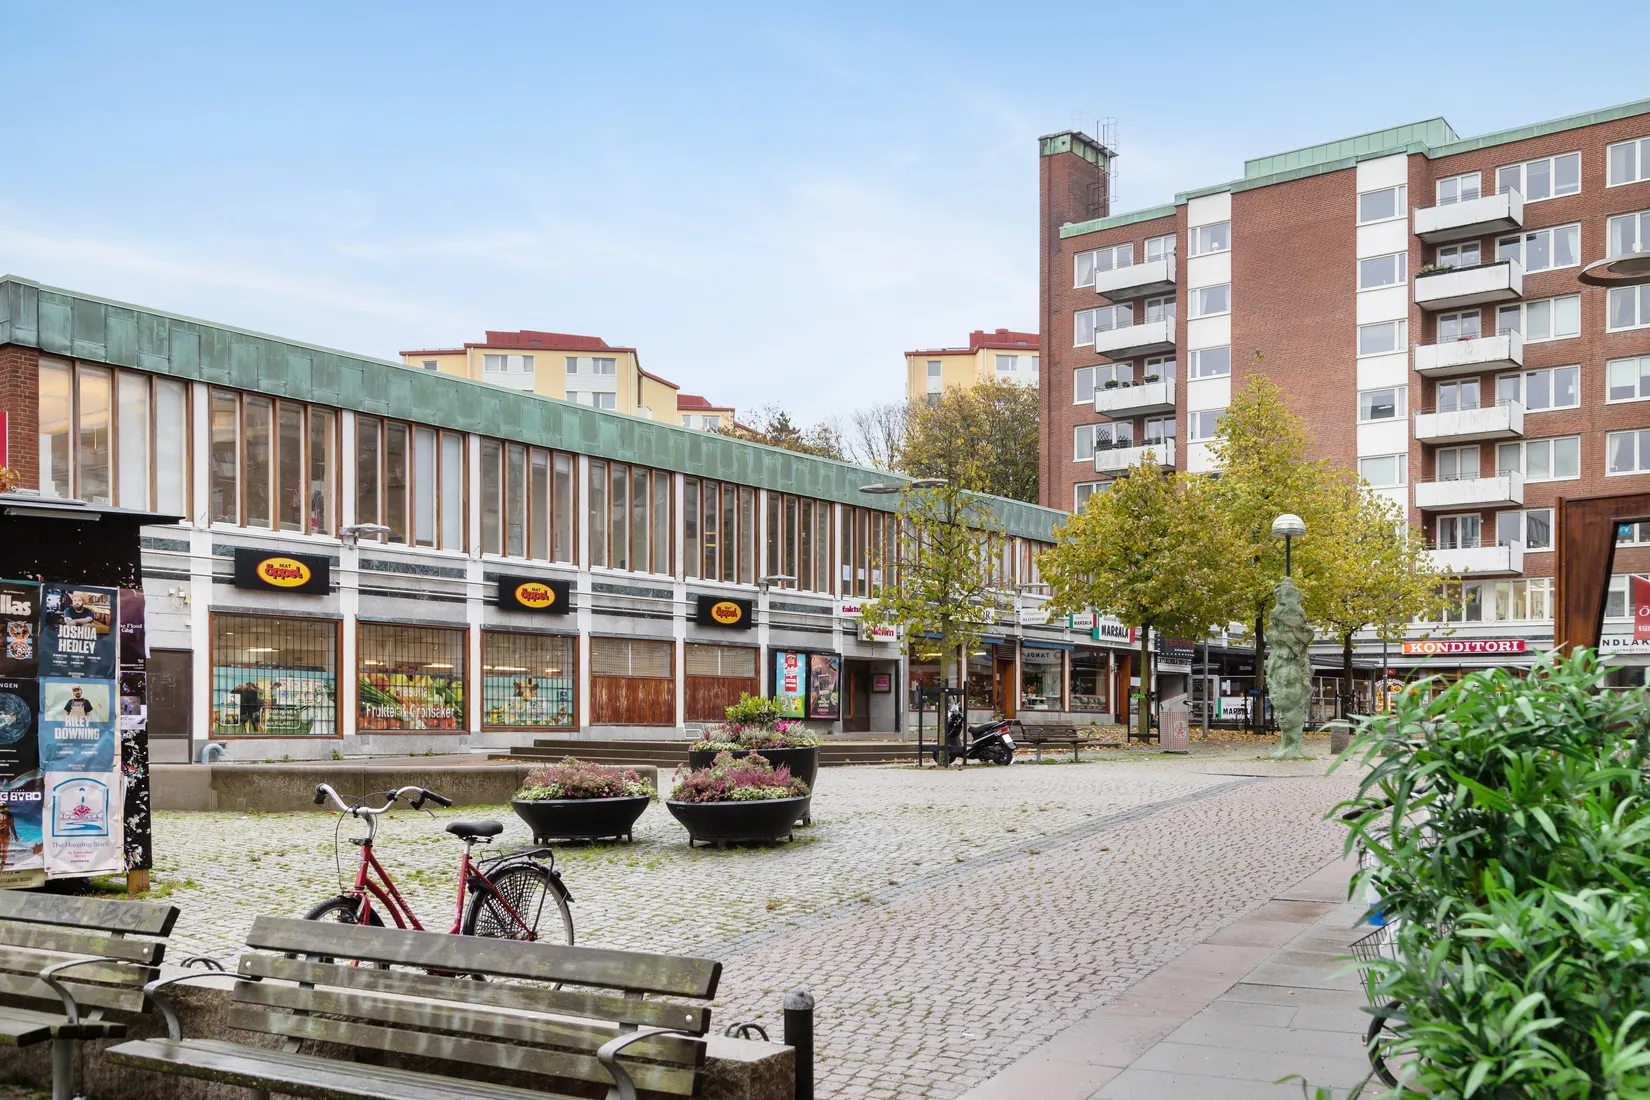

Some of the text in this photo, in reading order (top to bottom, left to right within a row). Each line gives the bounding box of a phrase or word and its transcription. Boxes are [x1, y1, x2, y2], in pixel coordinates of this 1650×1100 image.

[842, 605, 862, 613] faktu
[57, 624, 97, 640] JOSHUA
[1101, 624, 1129, 639] MARSALA
[58, 639, 96, 655] HEDLEY
[1410, 641, 1519, 653] KONDITORI
[366, 702, 399, 718] Frukter
[409, 703, 455, 719] Grönsaker
[64, 714, 91, 727] RILEY
[54, 727, 100, 740] DOWNING
[65, 841, 92, 849] Hanging
